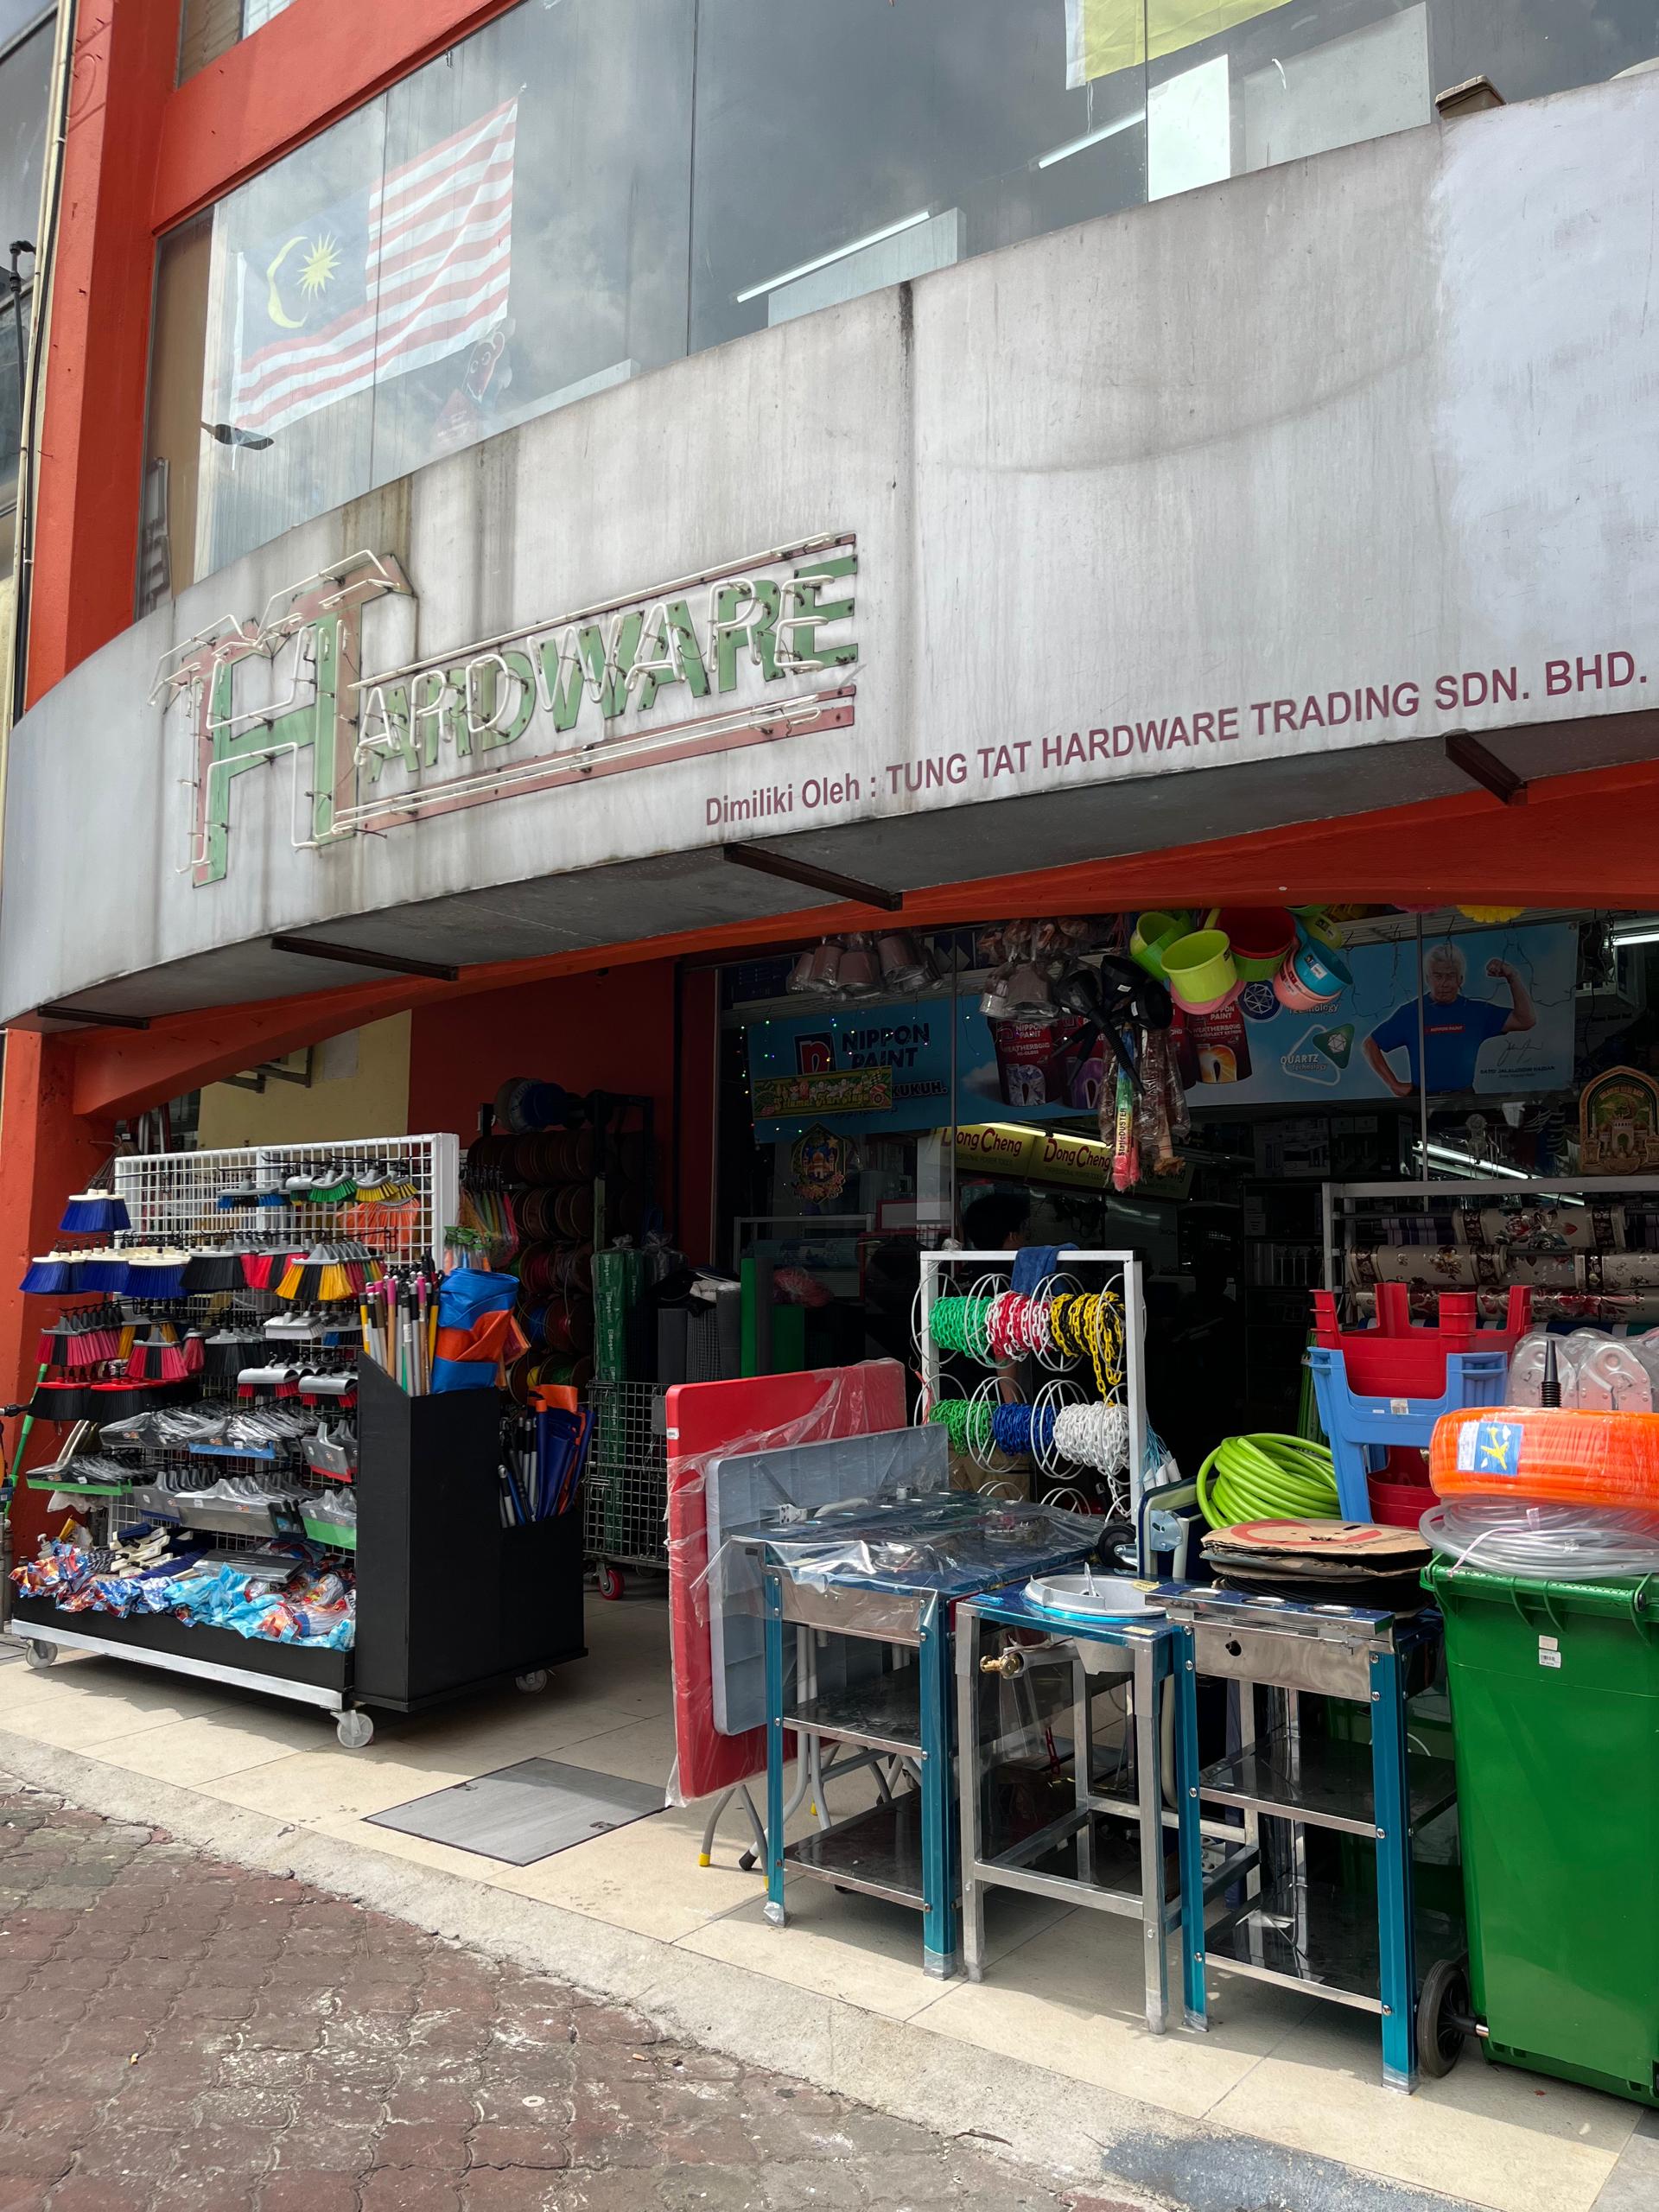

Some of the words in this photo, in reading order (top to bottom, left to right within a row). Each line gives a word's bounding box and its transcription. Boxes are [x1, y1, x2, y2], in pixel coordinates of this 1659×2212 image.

[162, 551, 860, 888] HARDWARE
[706, 782, 794, 825] Dimiliki
[802, 772, 860, 810] Oleh
[886, 752, 968, 795] TUNG
[977, 741, 1033, 779] TAT
[1043, 706, 1239, 768] HARDWARE
[1251, 682, 1421, 736] TRADING
[1434, 666, 1529, 711] SDN.
[1546, 651, 1648, 697] BHD.
[1211, 1012, 1233, 1020] PAINT
[842, 1023, 931, 1052] NIPPON
[852, 1047, 918, 1070] PAINT
[1280, 1053, 1319, 1065] QUARTZ
